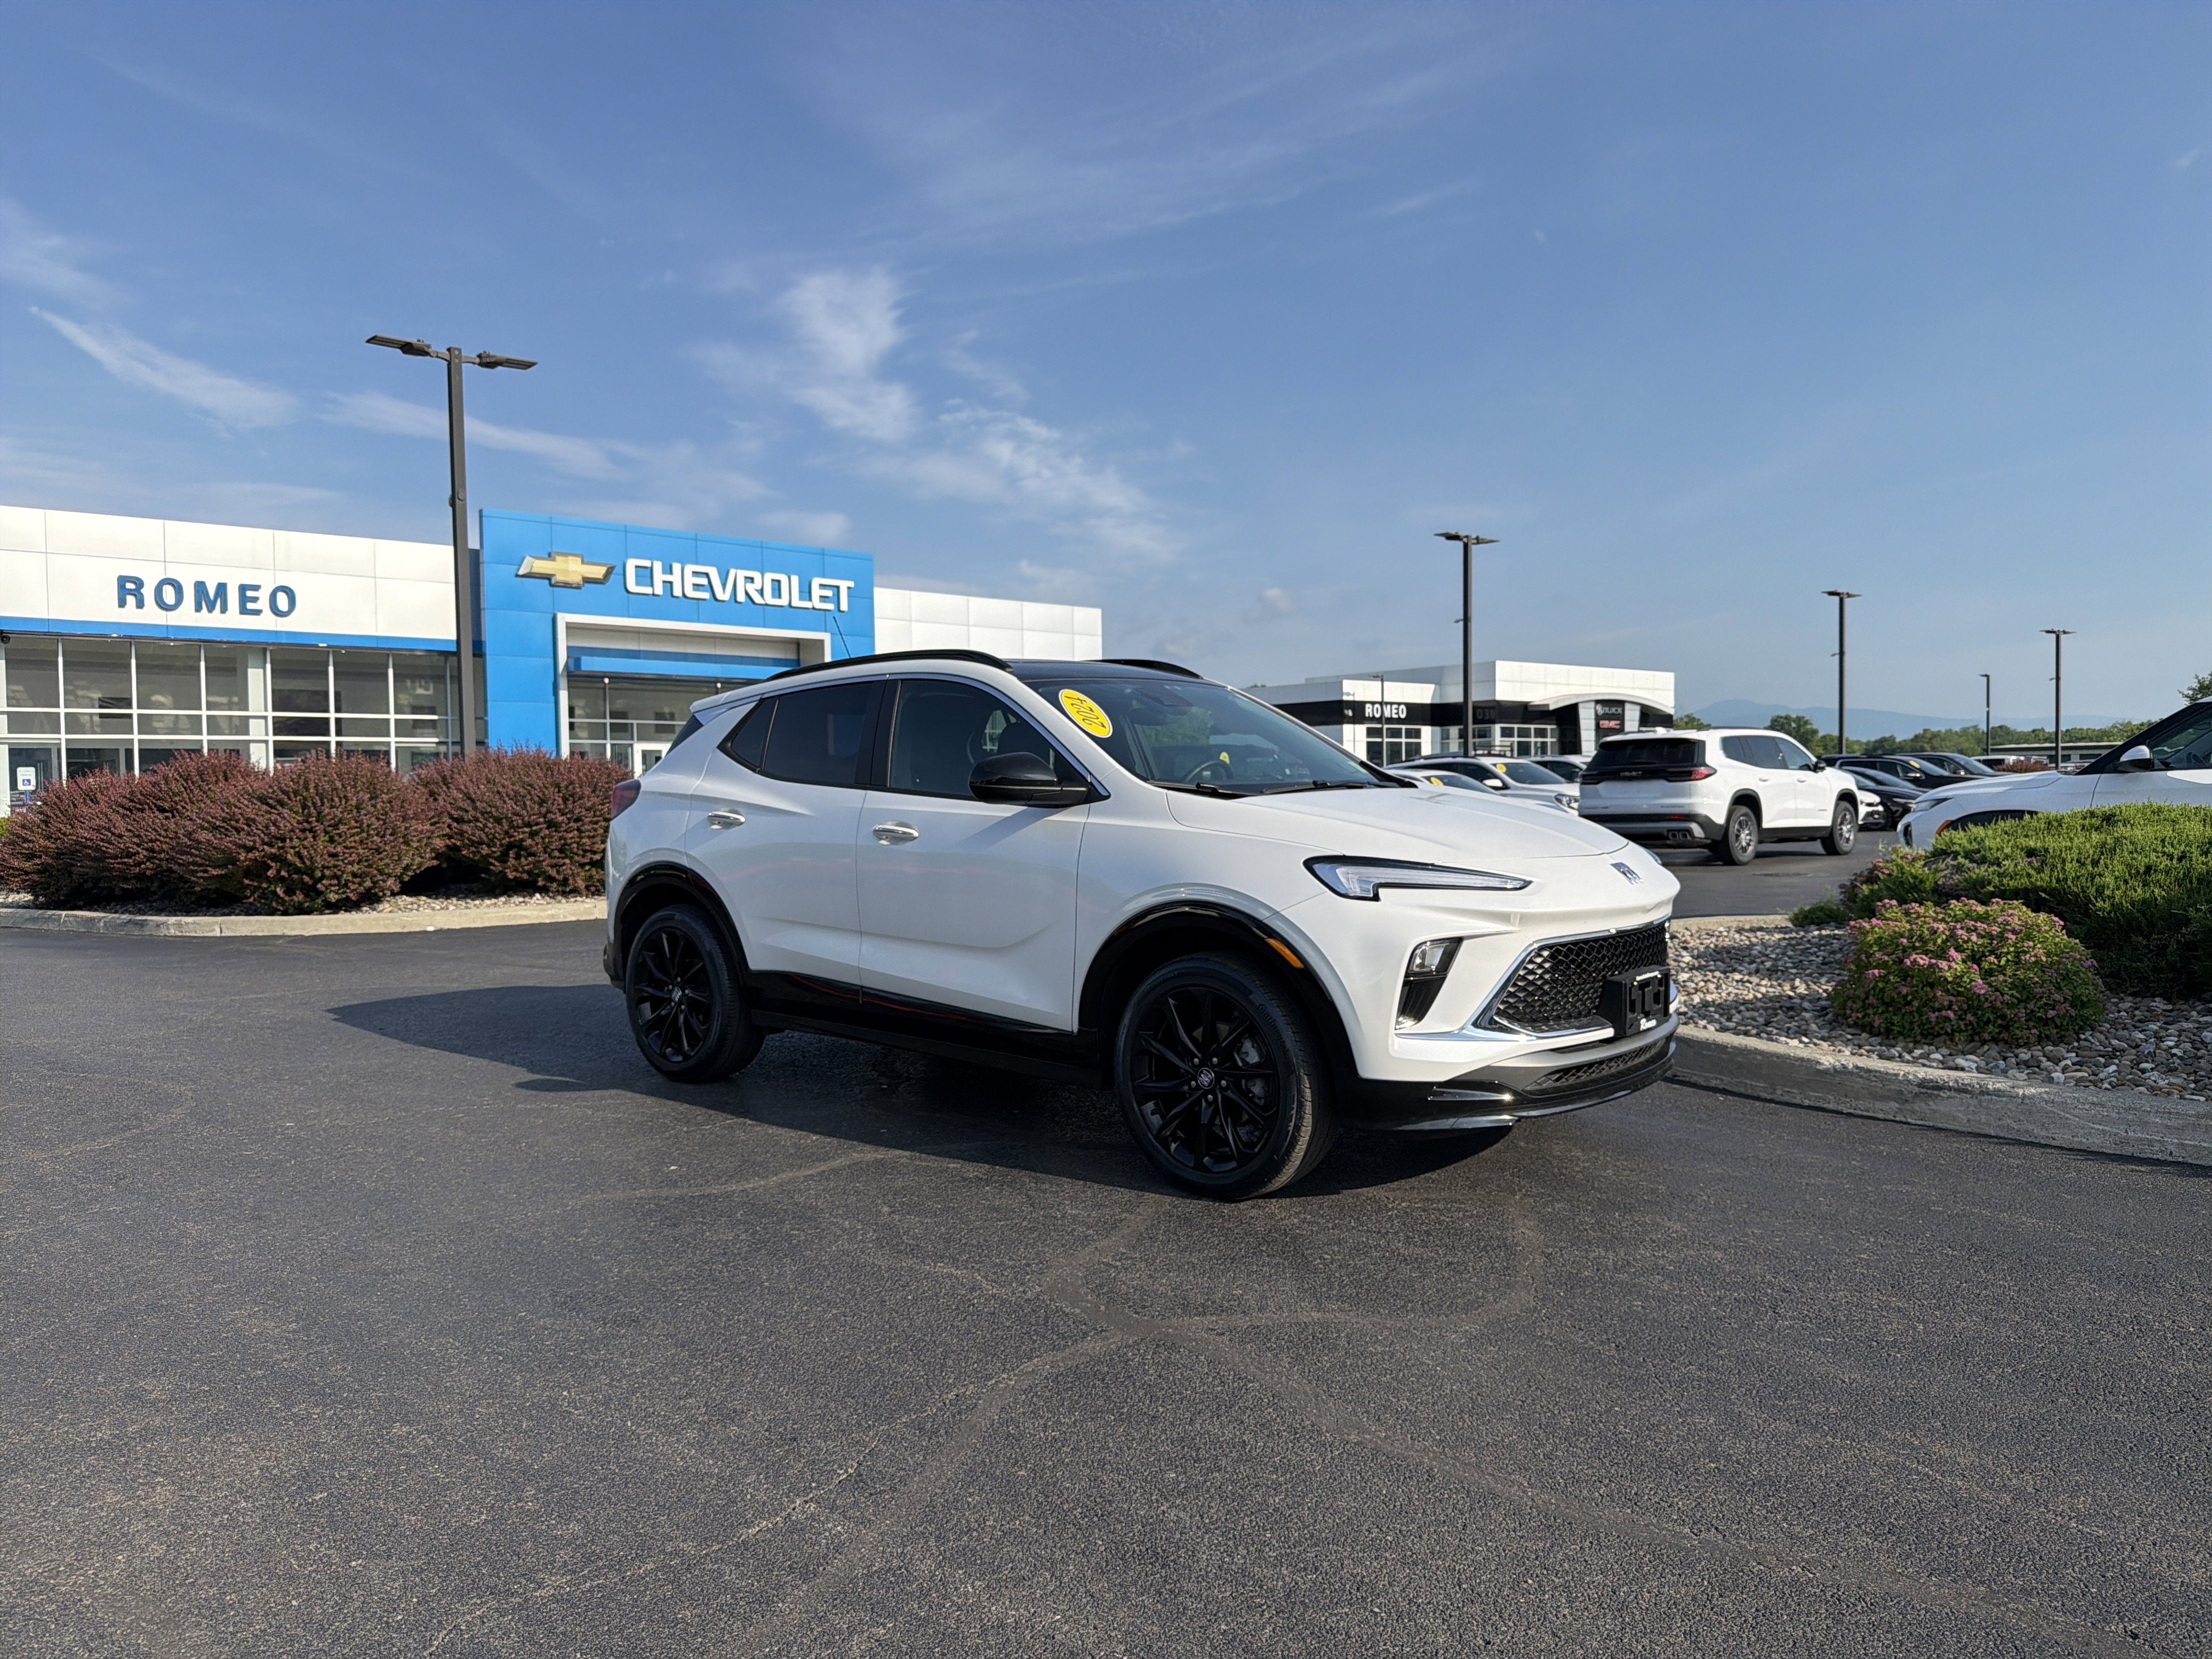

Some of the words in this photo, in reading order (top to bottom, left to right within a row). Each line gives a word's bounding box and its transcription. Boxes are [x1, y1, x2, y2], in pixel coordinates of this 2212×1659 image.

[116, 574, 297, 618] ROMEO
[625, 557, 855, 612] CHEVROLET
[1064, 695, 1107, 729] 2024
[1365, 703, 1407, 719] ROMEO
